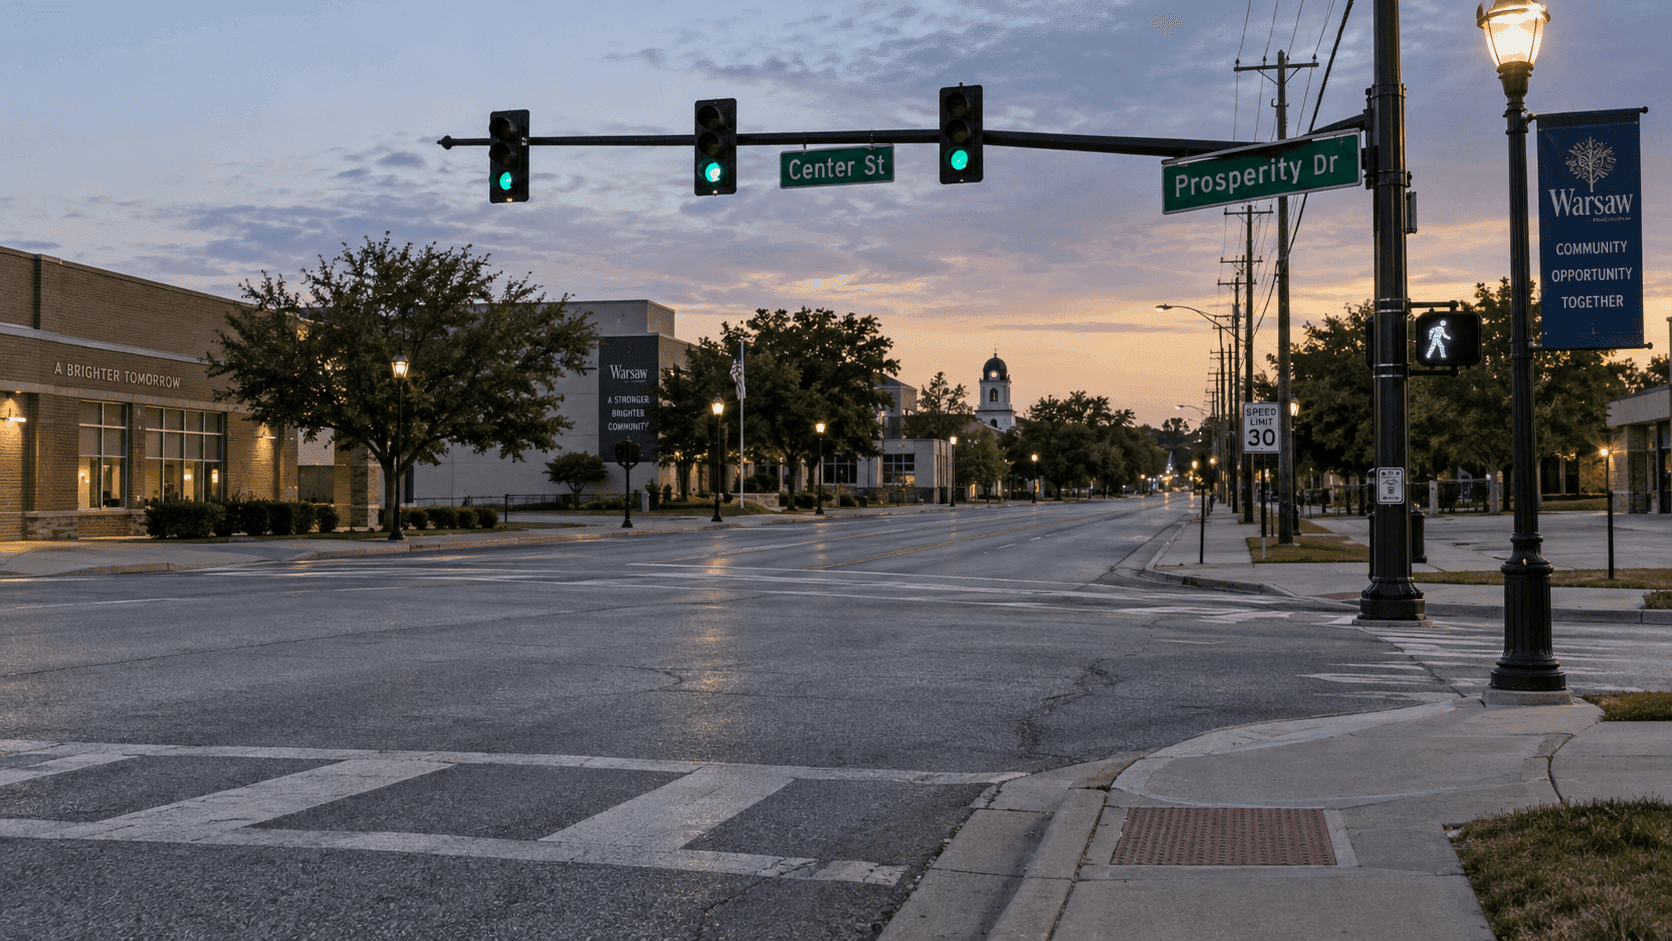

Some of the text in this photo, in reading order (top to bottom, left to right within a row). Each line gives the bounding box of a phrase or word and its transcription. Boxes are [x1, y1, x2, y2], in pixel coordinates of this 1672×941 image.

[789, 154, 885, 180] Center St
[1175, 153, 1339, 197] Prosperity Dr
[1548, 188, 1633, 218] Warsaw
[1555, 240, 1628, 255] COMMUNITY
[1551, 267, 1633, 282] OPPORTUNITY
[1561, 294, 1624, 309] TOGETHER
[54, 361, 181, 389] A BRIGHTER TOMORROW
[610, 364, 648, 379] Warsaw
[607, 395, 649, 404] A STRONGER
[611, 409, 645, 417] BRIGHTER
[608, 422, 649, 430] COMMUNITY
[1248, 428, 1275, 446] 30
